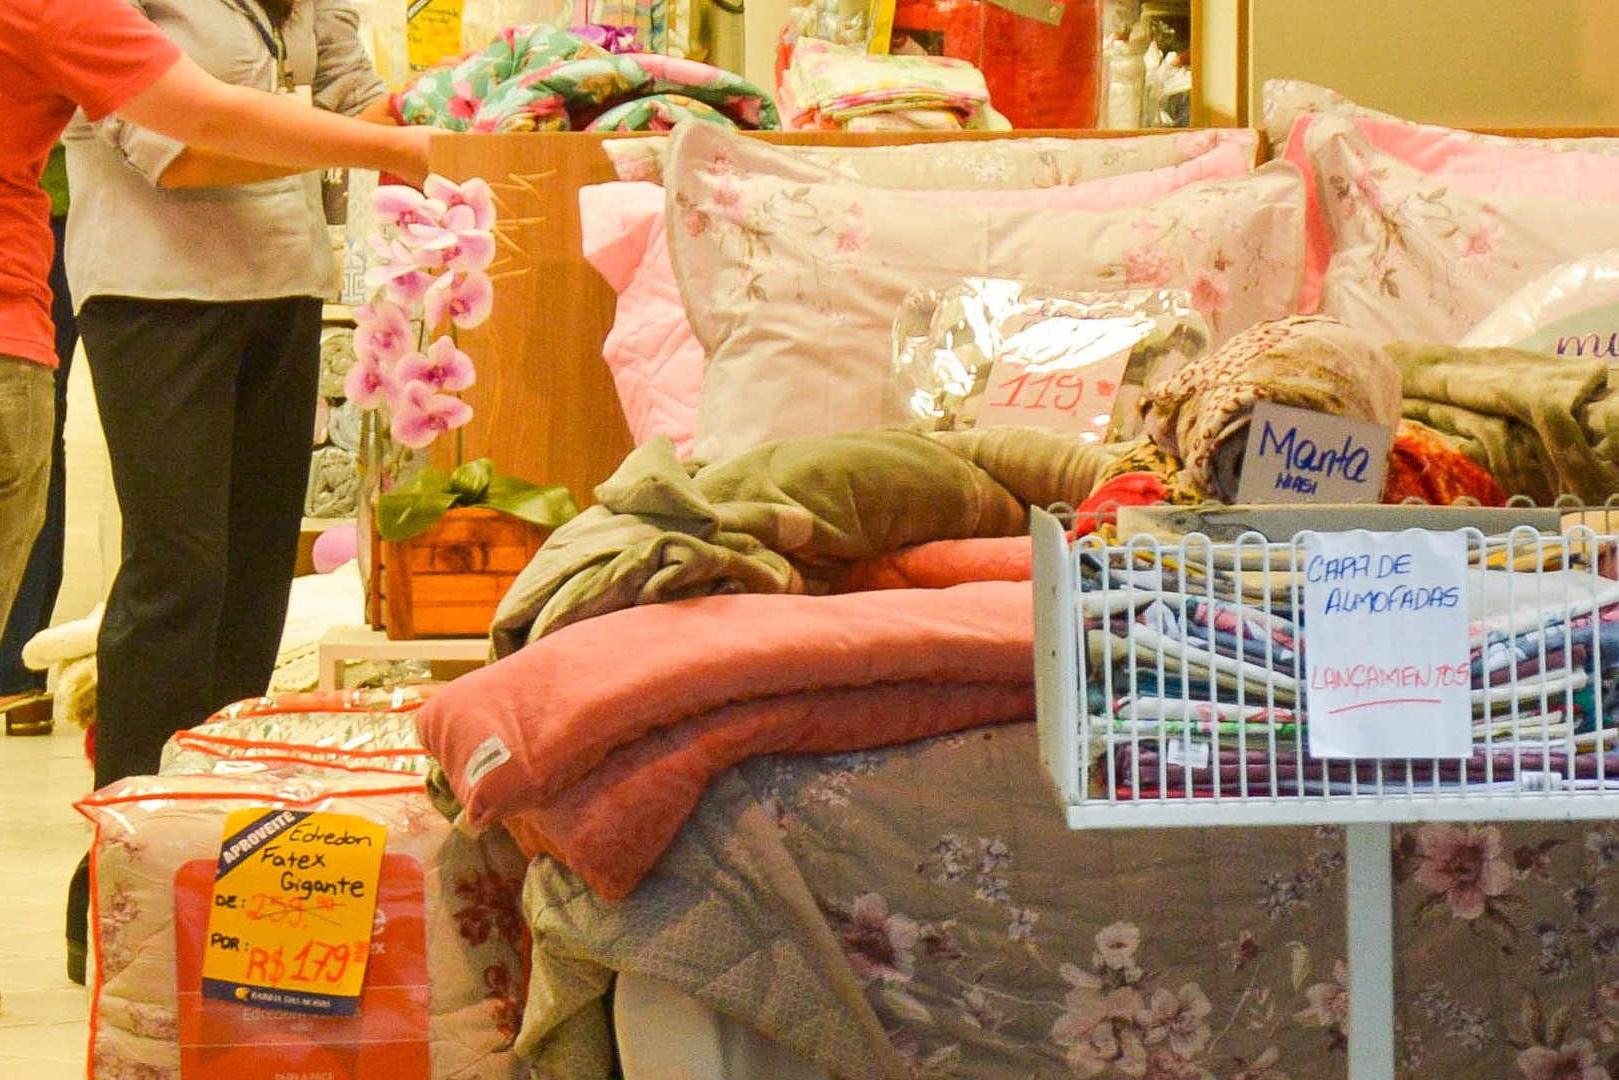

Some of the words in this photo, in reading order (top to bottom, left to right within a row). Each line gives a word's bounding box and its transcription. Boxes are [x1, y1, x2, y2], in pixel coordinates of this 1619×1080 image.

[1259, 420, 1369, 483] Manta
[1307, 553, 1370, 583] CAPA
[1377, 554, 1412, 579] DE
[1325, 584, 1460, 615] ALMOFADAS
[1311, 662, 1470, 697] LANÇAMENTOS
[223, 810, 296, 864] APROVEITE
[261, 846, 326, 869] Fatex
[281, 871, 364, 900] Gigante
